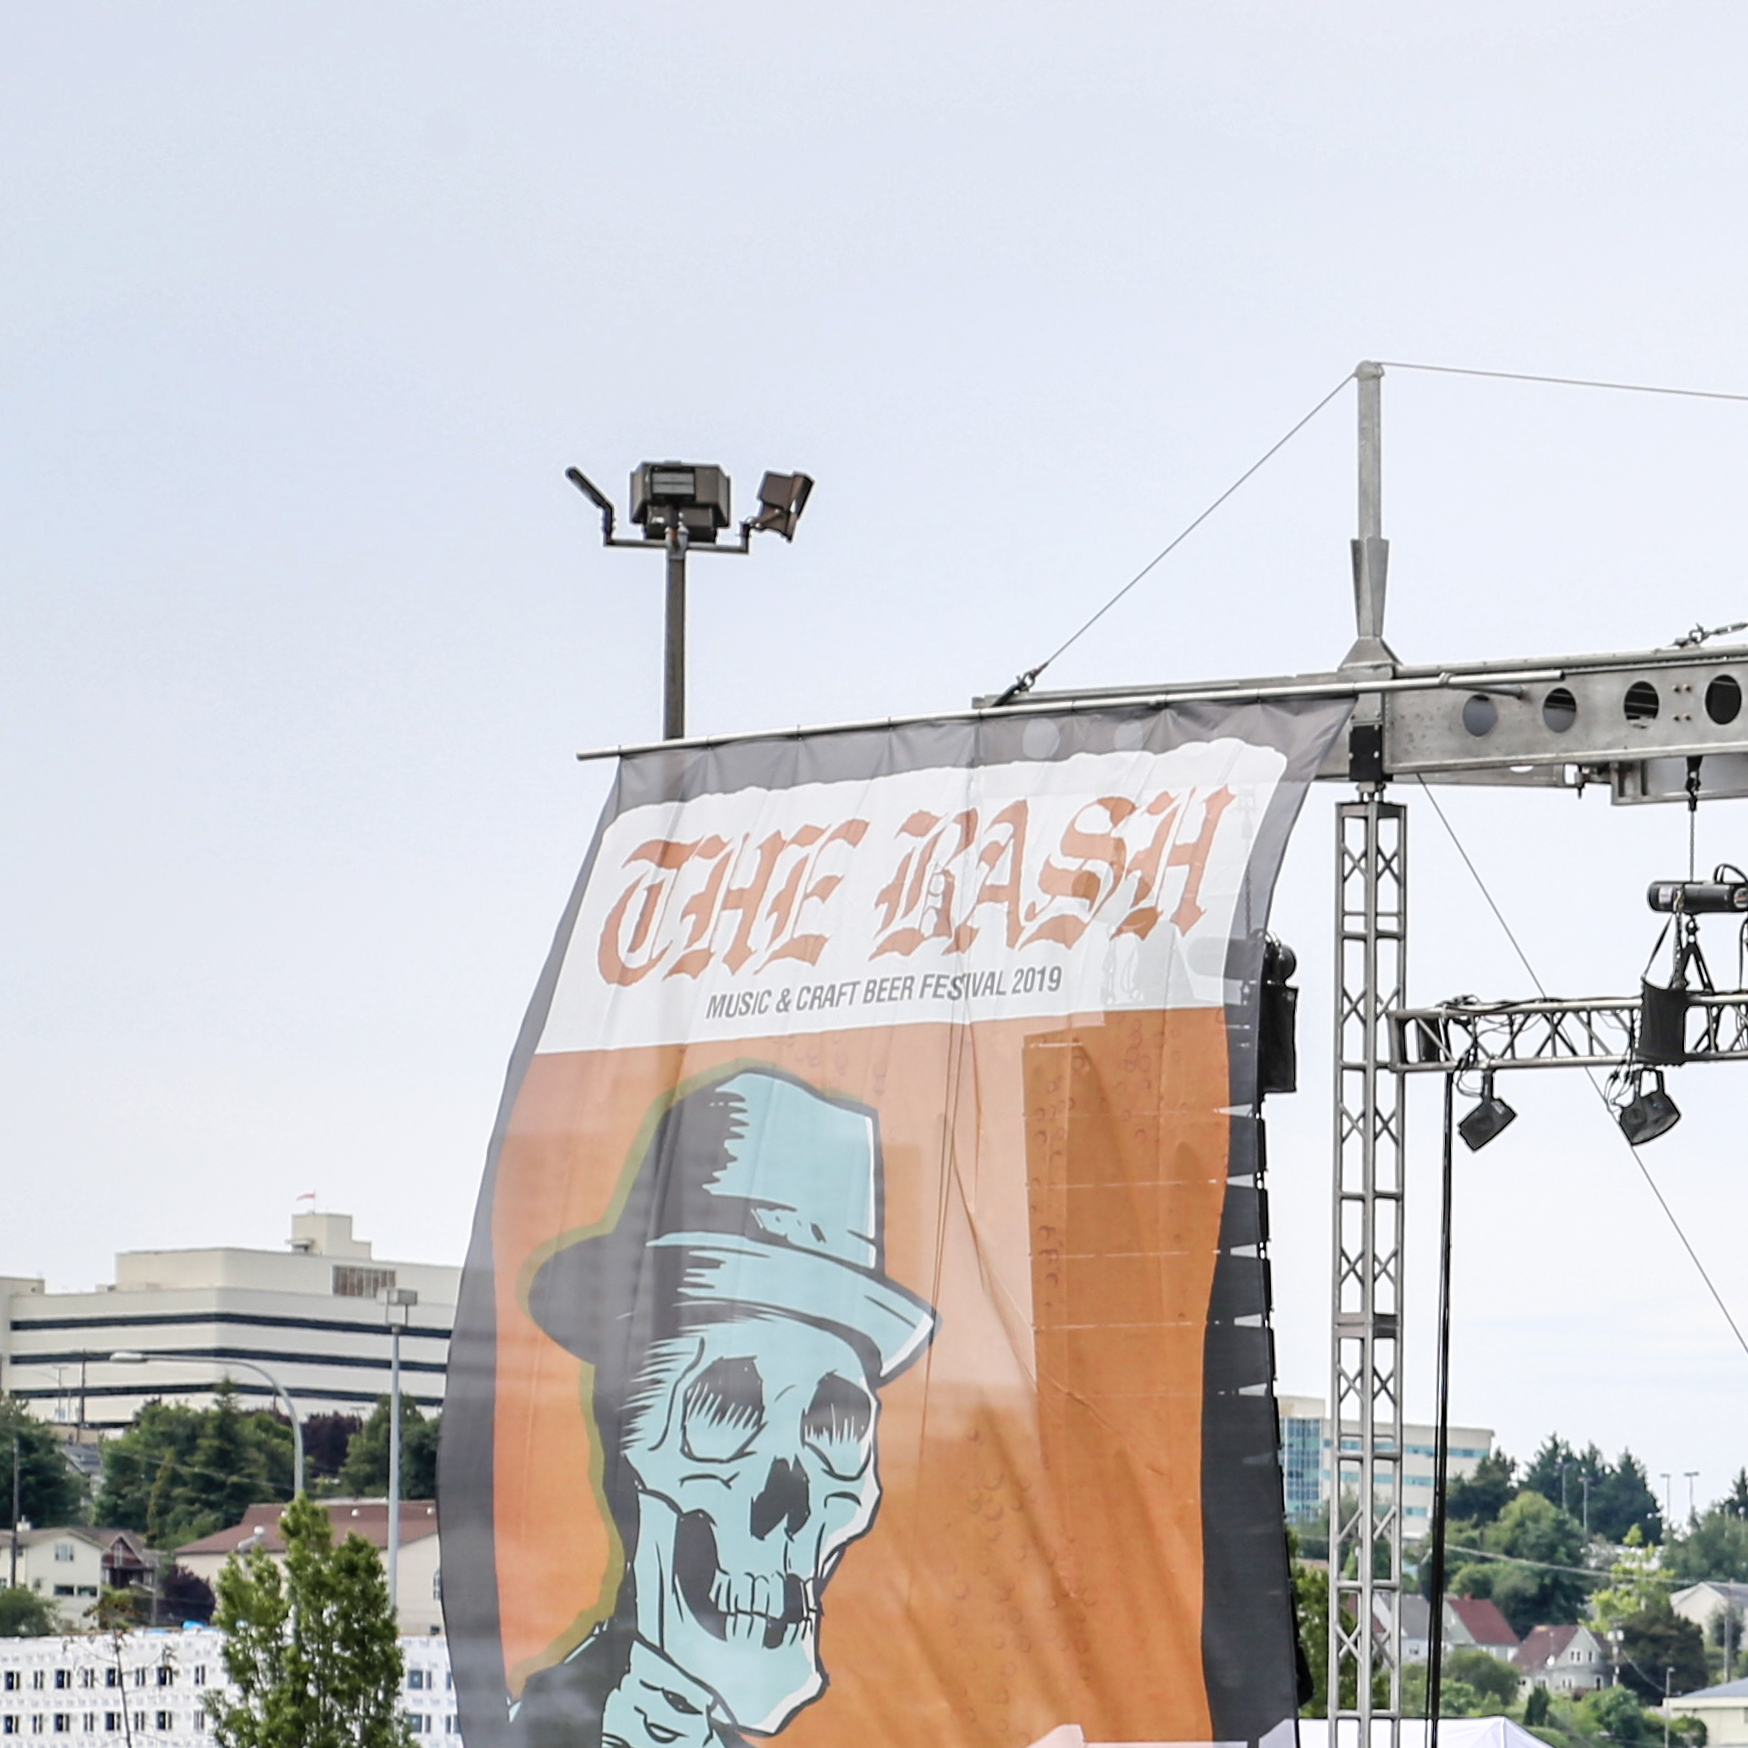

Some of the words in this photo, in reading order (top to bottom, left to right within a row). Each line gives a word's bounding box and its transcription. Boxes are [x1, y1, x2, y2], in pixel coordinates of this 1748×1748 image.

[598, 817, 871, 987] THE
[868, 783, 1239, 962] BASH
[705, 989, 772, 1020] MUSIC
[775, 990, 791, 1014] &
[795, 980, 860, 1012] CRAFT
[862, 975, 916, 1005] BEER
[1011, 966, 1062, 995] 2019
